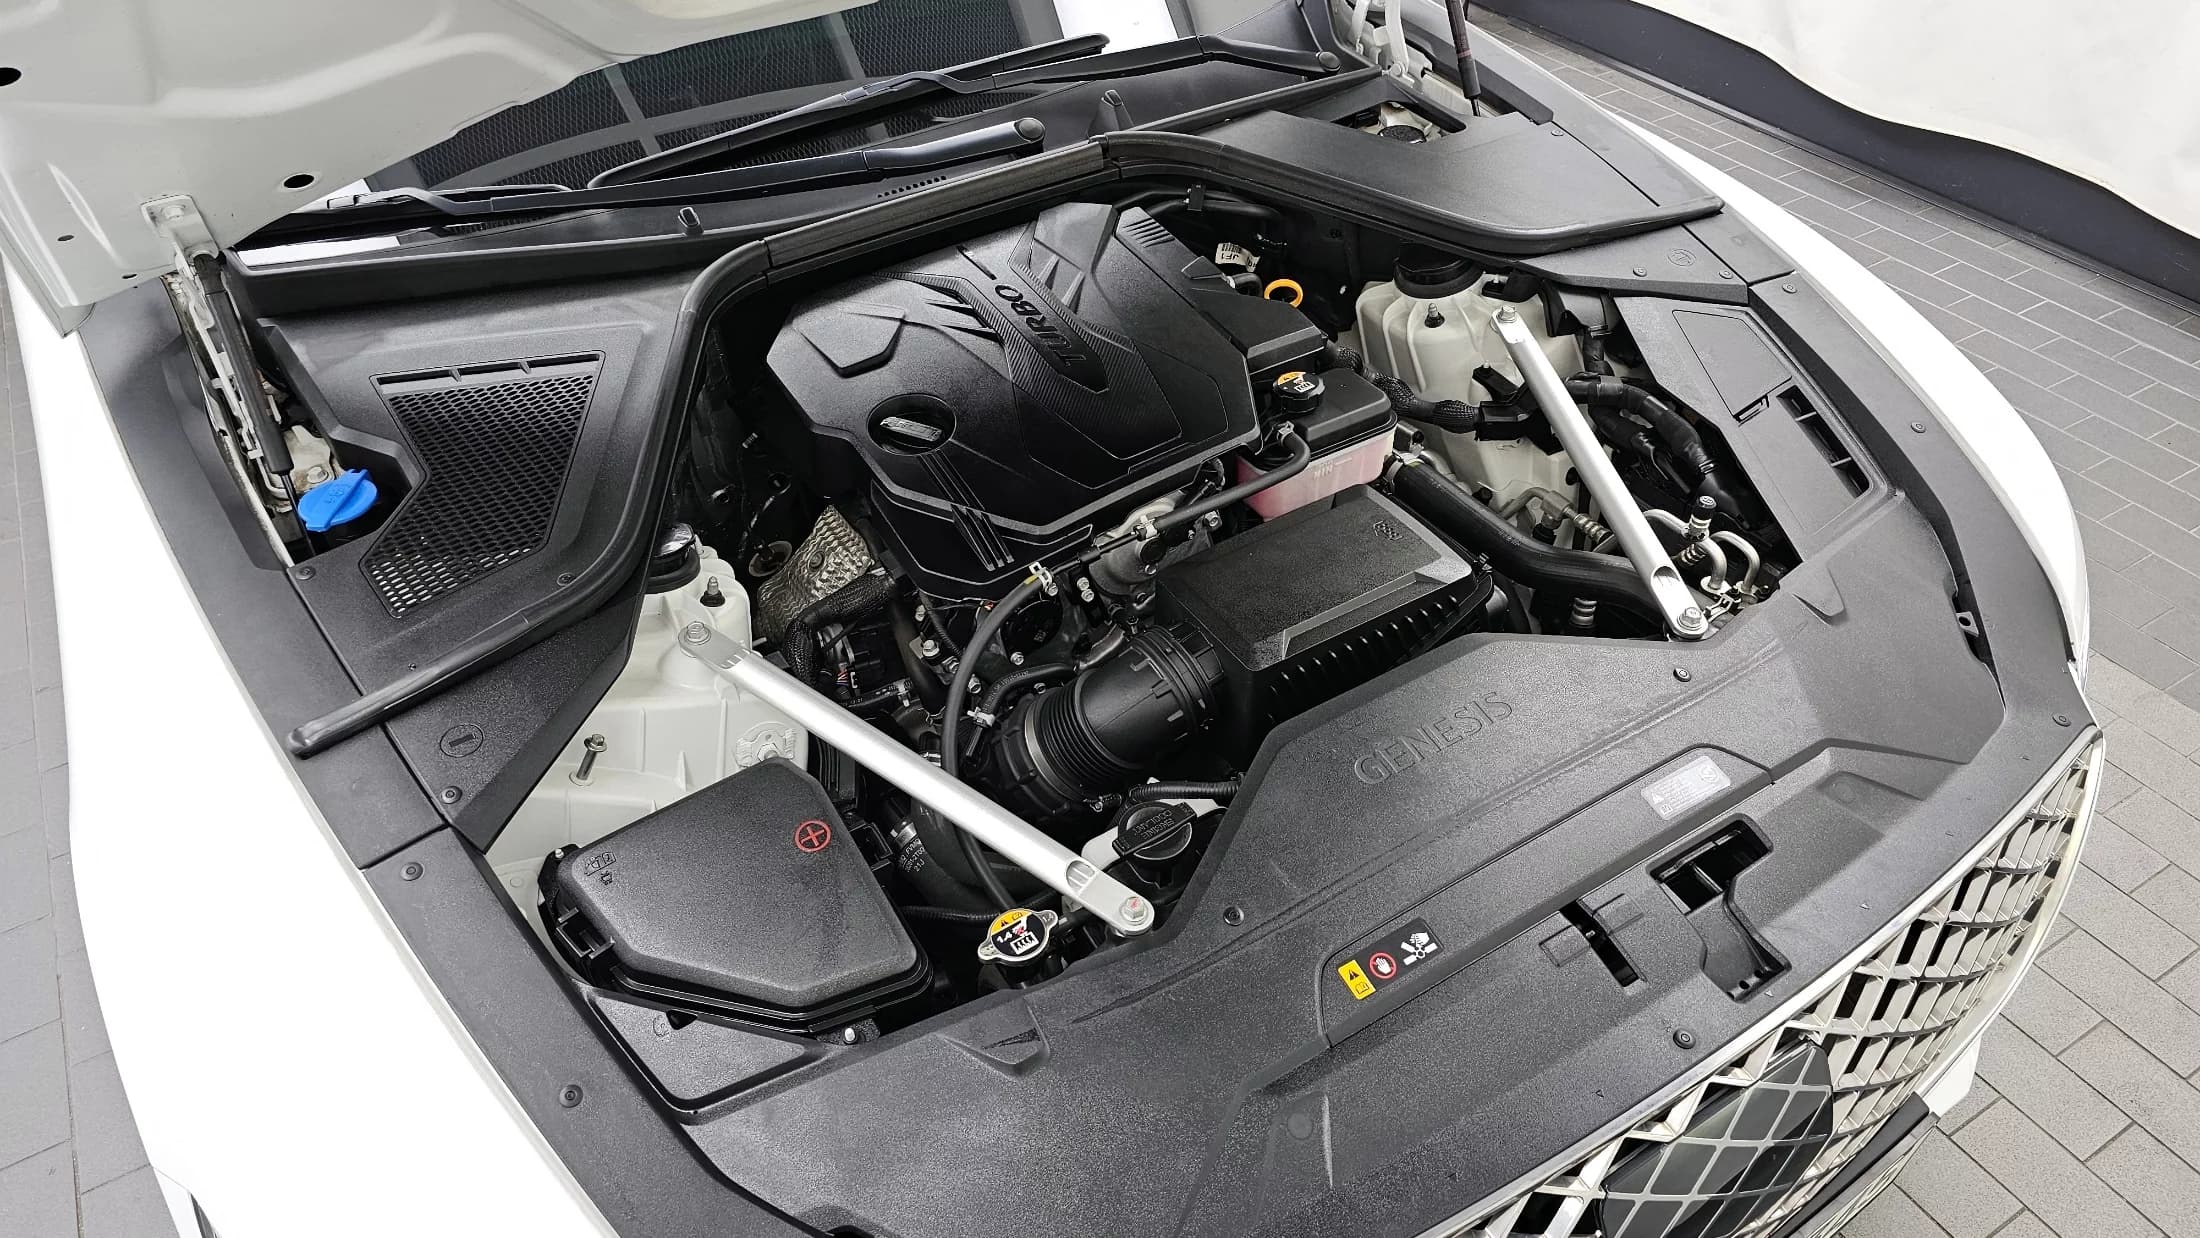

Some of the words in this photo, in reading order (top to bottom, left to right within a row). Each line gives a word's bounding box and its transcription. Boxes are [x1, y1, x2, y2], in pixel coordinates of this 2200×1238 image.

[995, 284, 1087, 367] TURBO
[1354, 691, 1513, 784] GENESIS
[1141, 818, 1175, 840] ENGINE
